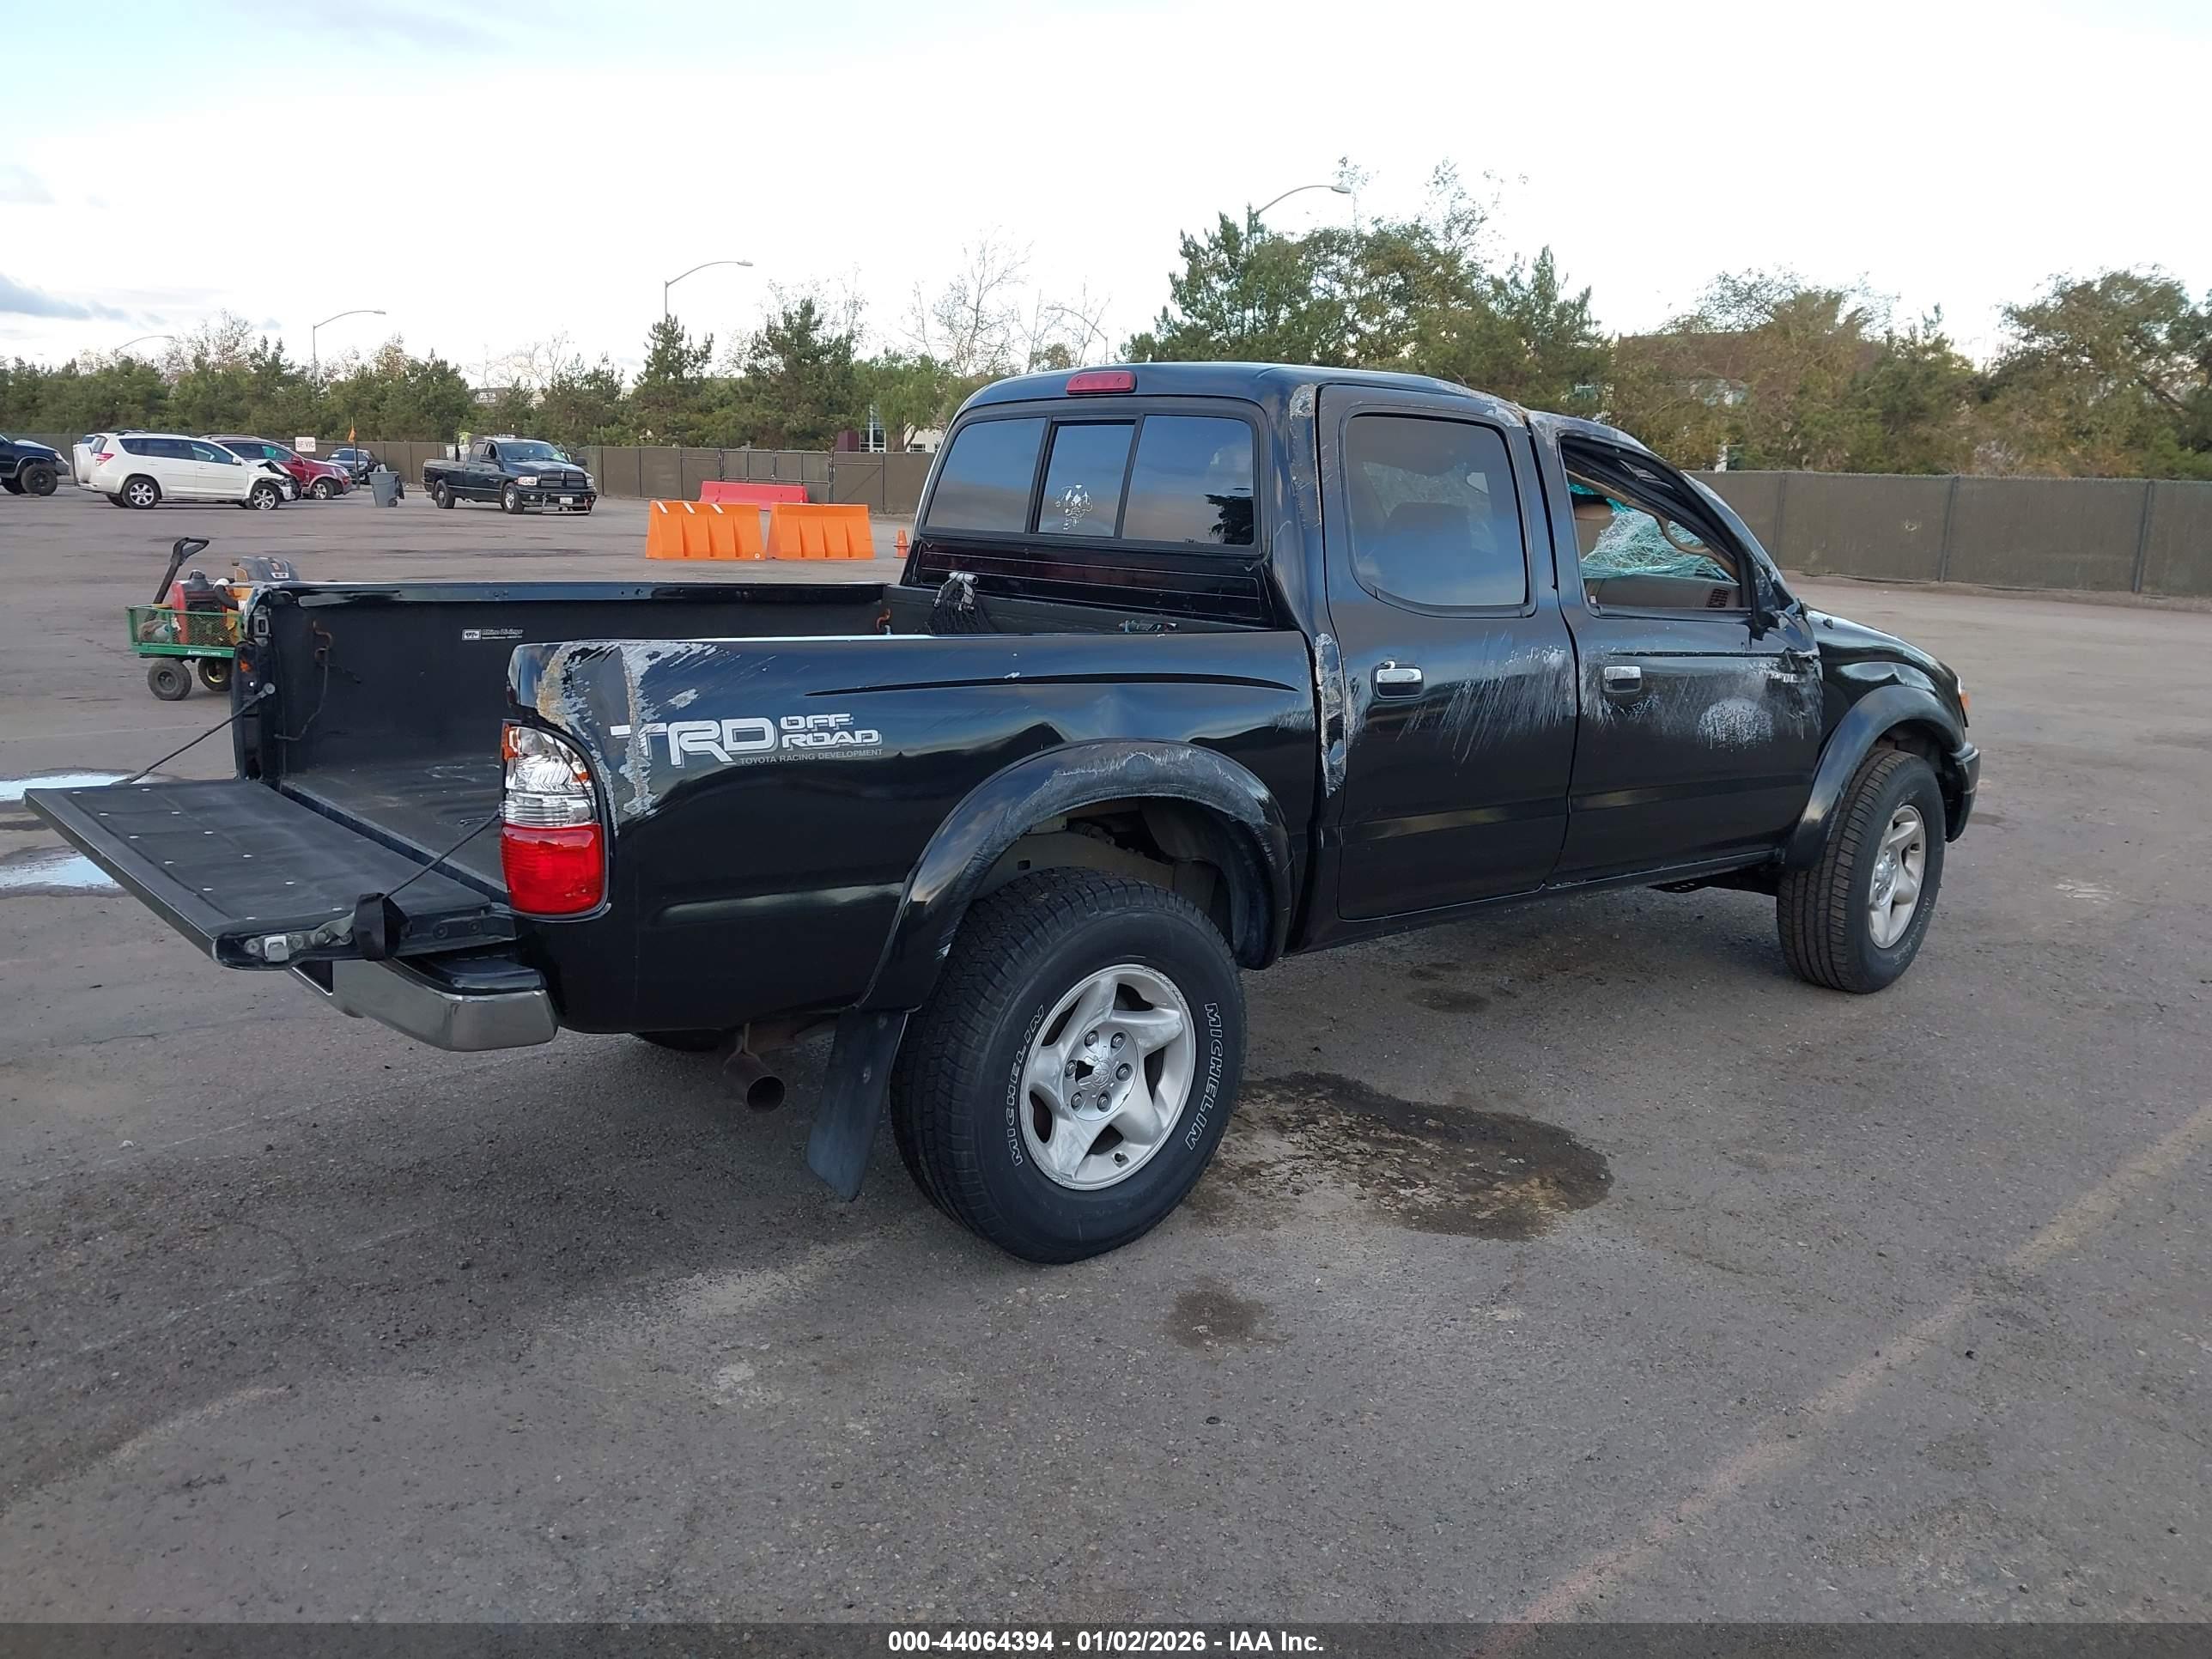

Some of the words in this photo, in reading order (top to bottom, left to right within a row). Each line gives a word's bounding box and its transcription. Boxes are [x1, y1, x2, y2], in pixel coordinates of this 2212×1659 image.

[781, 713, 854, 732] OFF
[781, 729, 883, 750] ROAD
[610, 717, 779, 769] TRD
[740, 757, 777, 765] TOYOTA
[779, 753, 815, 763] RACING
[817, 748, 884, 760] DEVELOPMENT
[1005, 1004, 1045, 1166] MICHELIN
[1185, 1002, 1224, 1152] MICHELIN
